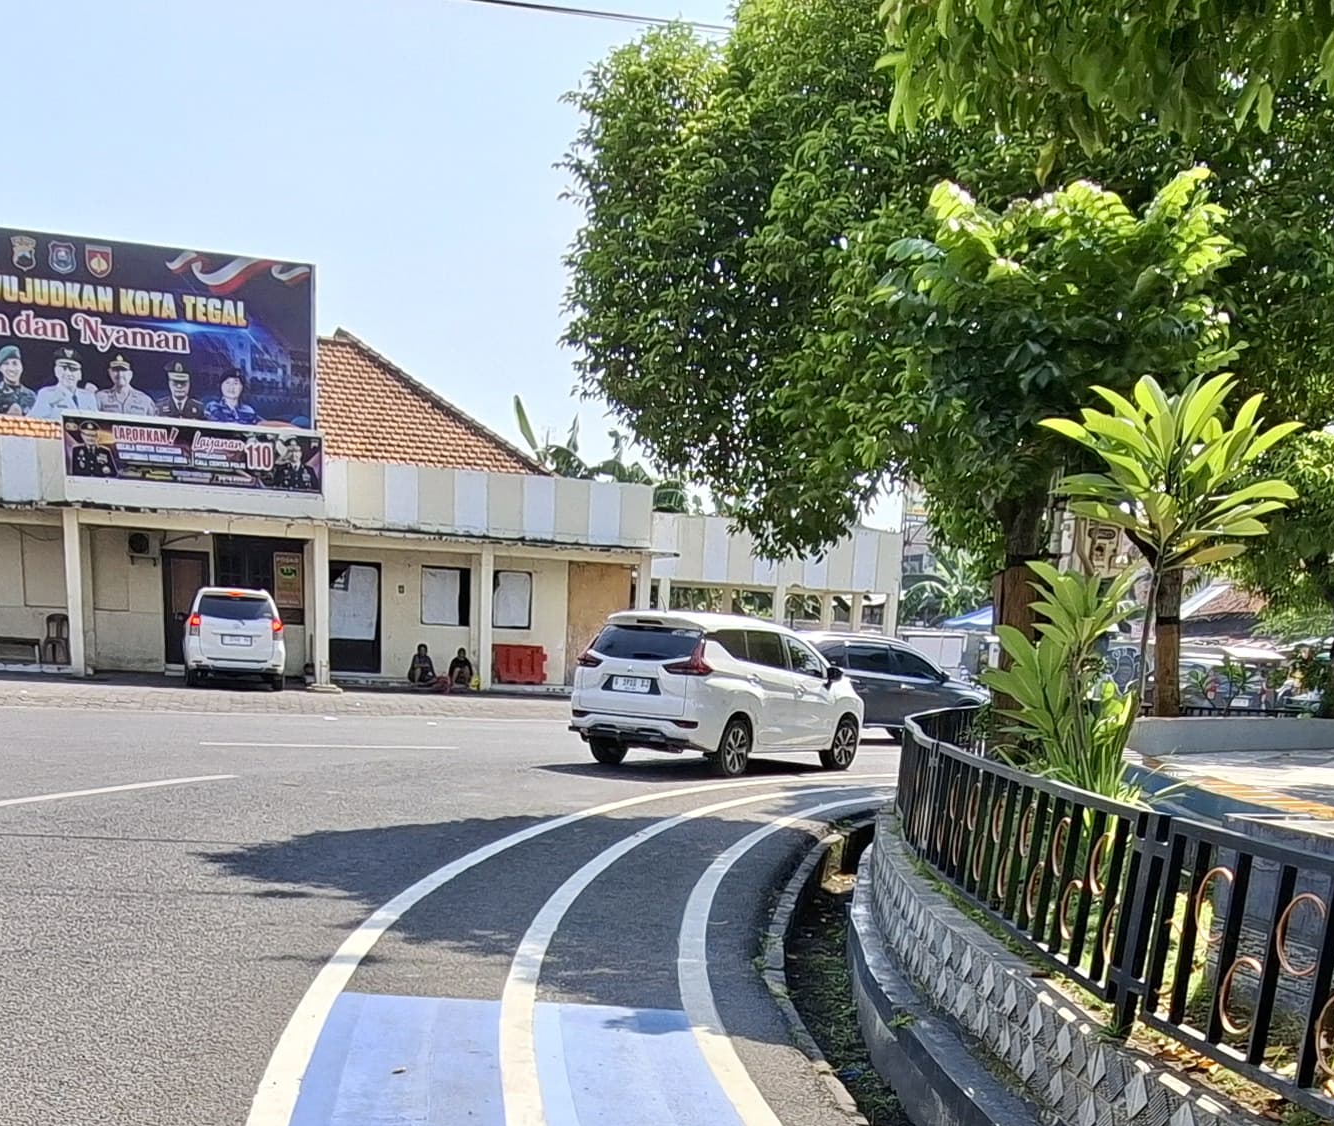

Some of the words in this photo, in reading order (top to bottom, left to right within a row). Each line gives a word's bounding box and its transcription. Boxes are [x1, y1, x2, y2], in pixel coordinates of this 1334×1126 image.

[119, 288, 177, 320] KOTA
[183, 294, 247, 328] TEGAL
[14, 310, 69, 341] dan
[71, 313, 190, 352] Nyaman
[192, 431, 245, 453] Layanan
[245, 443, 274, 471] 110
